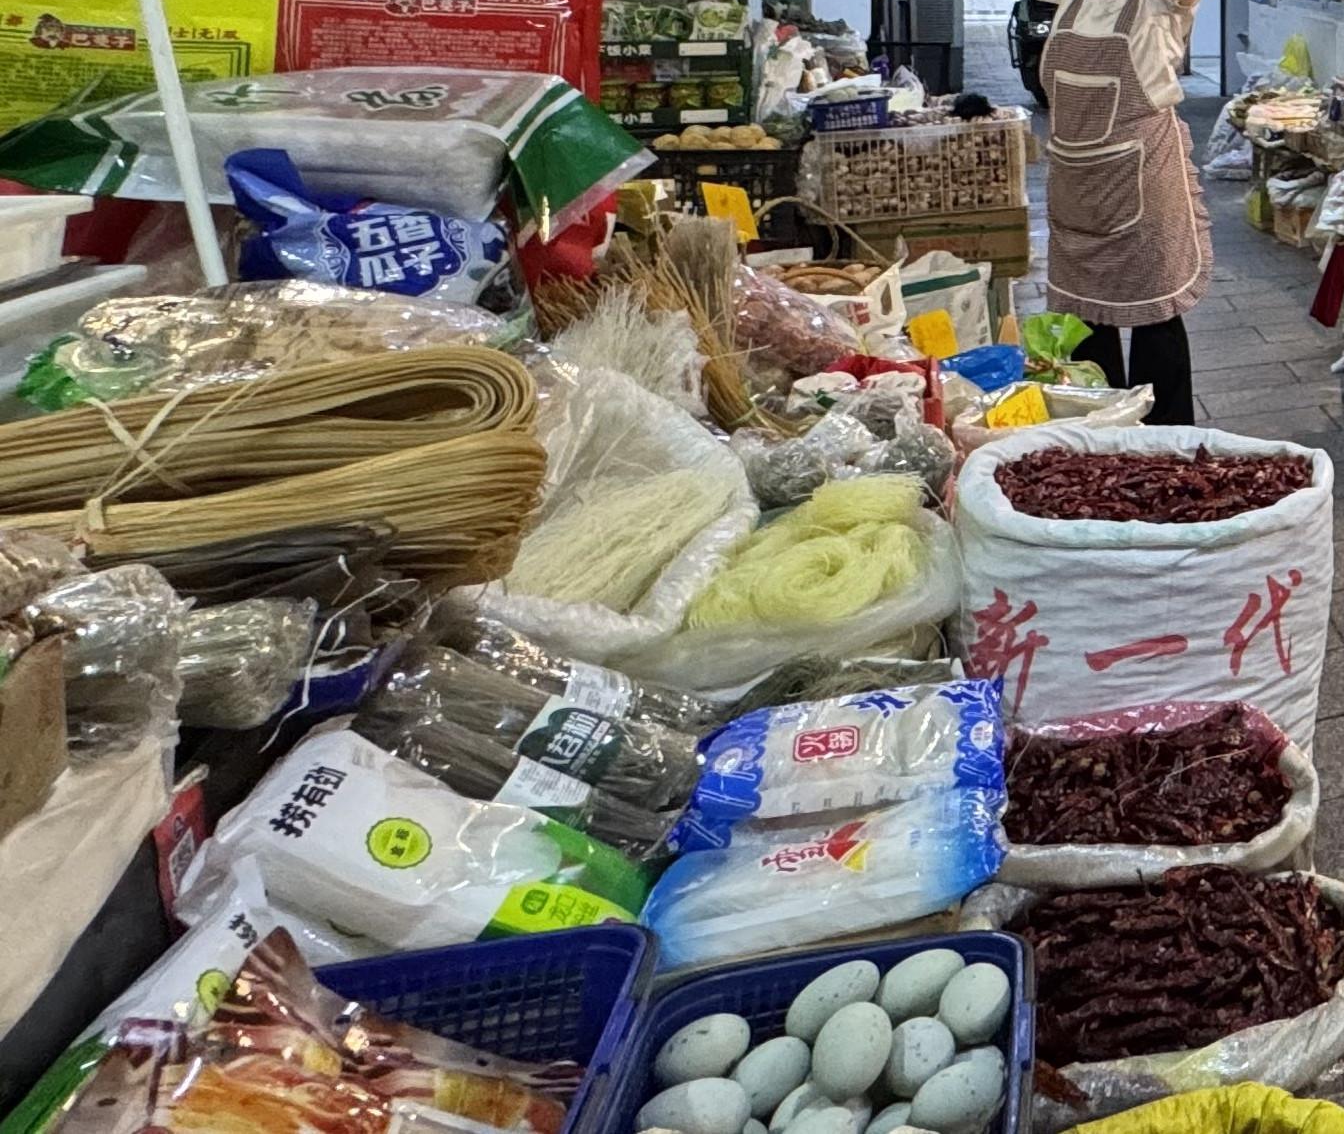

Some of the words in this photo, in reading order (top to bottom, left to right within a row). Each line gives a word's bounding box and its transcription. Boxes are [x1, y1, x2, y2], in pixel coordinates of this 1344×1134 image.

[346, 215, 435, 250] 五香
[358, 240, 445, 287] 瓜子
[967, 568, 1303, 721] 新一代
